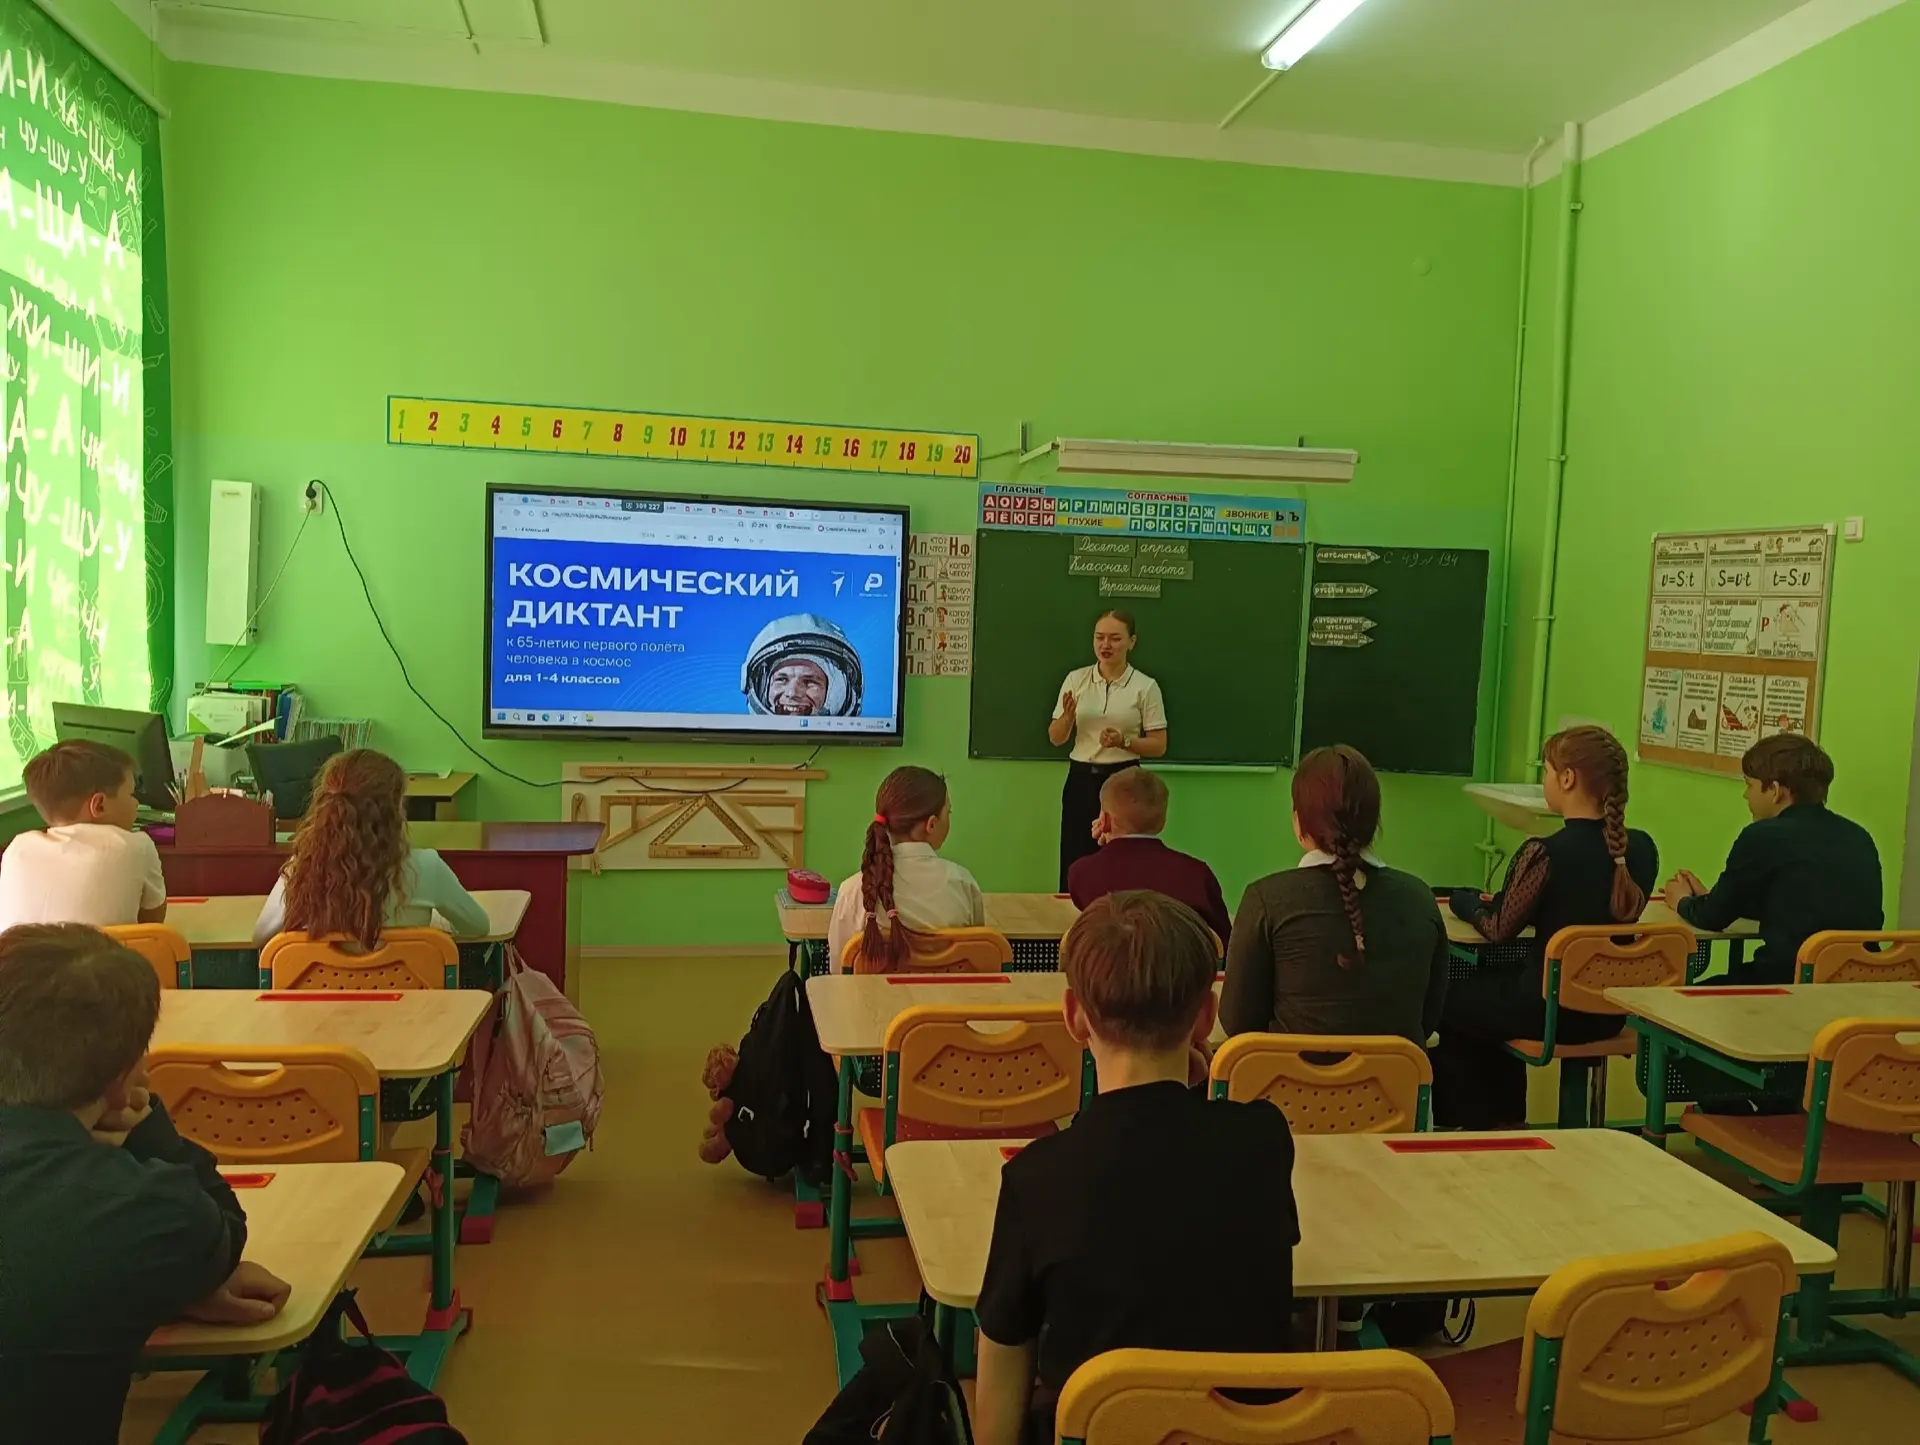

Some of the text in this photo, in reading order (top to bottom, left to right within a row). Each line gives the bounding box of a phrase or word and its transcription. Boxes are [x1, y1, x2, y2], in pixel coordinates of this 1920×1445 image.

[398, 409, 972, 465] 1 2 3 4 5 6 7 8 9 10 11 12 13 14 15 16 17 18 19 20
[995, 485, 1045, 494] ГЛАСНЫЕ
[1127, 492, 1189, 502] СОГЛАСНЫЕ
[1067, 517, 1104, 527] ГЛУХИЕ
[1225, 510, 1269, 520] ЗВОНКИЕ
[1079, 535, 1130, 553] Десятое
[1069, 555, 1187, 577] Классная работа
[509, 562, 800, 598] КОСМИЧЕСКИЙ
[506, 599, 684, 628] ДИКТАНТ
[506, 636, 685, 653] к 65-летию первого полёта
[506, 655, 632, 668] человека в космос
[504, 672, 621, 685] для 1-4 классов
